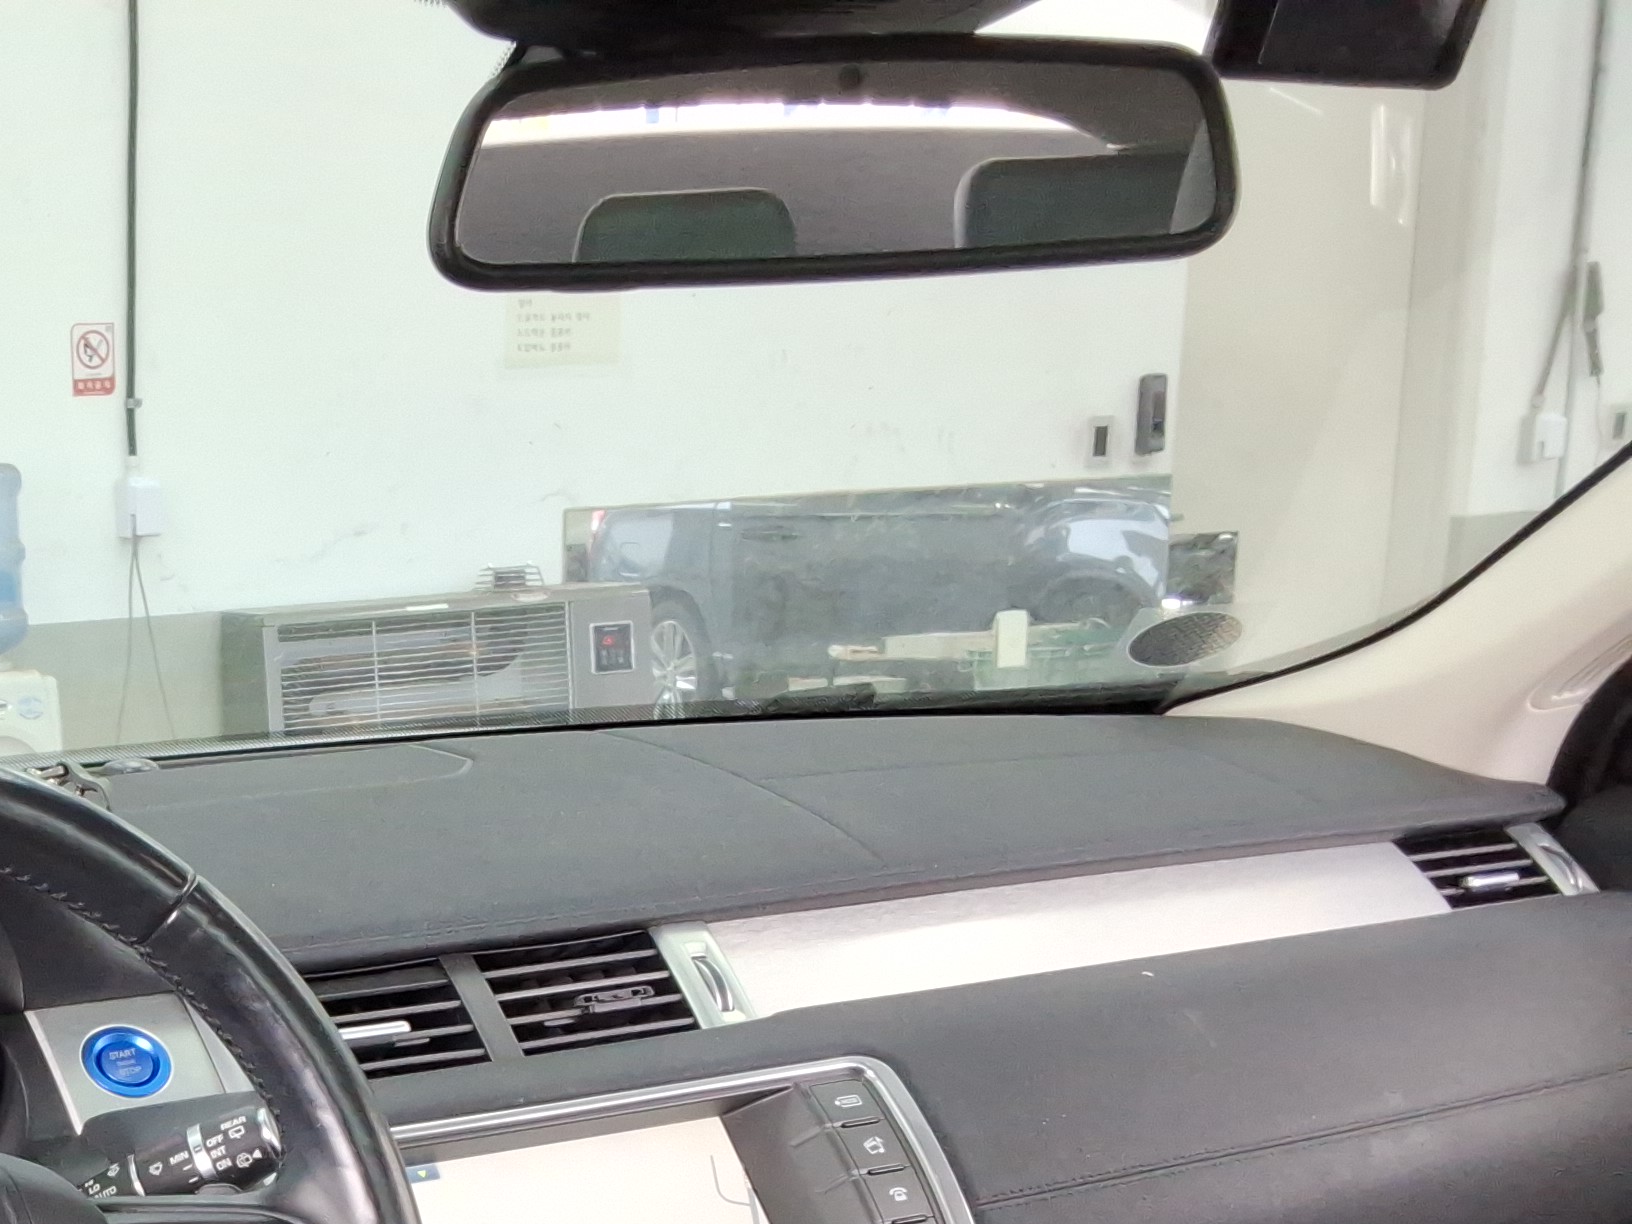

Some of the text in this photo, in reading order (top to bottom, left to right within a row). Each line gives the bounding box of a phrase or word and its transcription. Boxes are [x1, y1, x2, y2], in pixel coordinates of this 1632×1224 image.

[220, 1116, 246, 1131] REAR
[206, 1133, 224, 1148] OFF
[169, 1150, 189, 1166] MIN
[210, 1145, 227, 1159] INT
[216, 1157, 232, 1171] ON
[88, 1183, 101, 1195] LO
